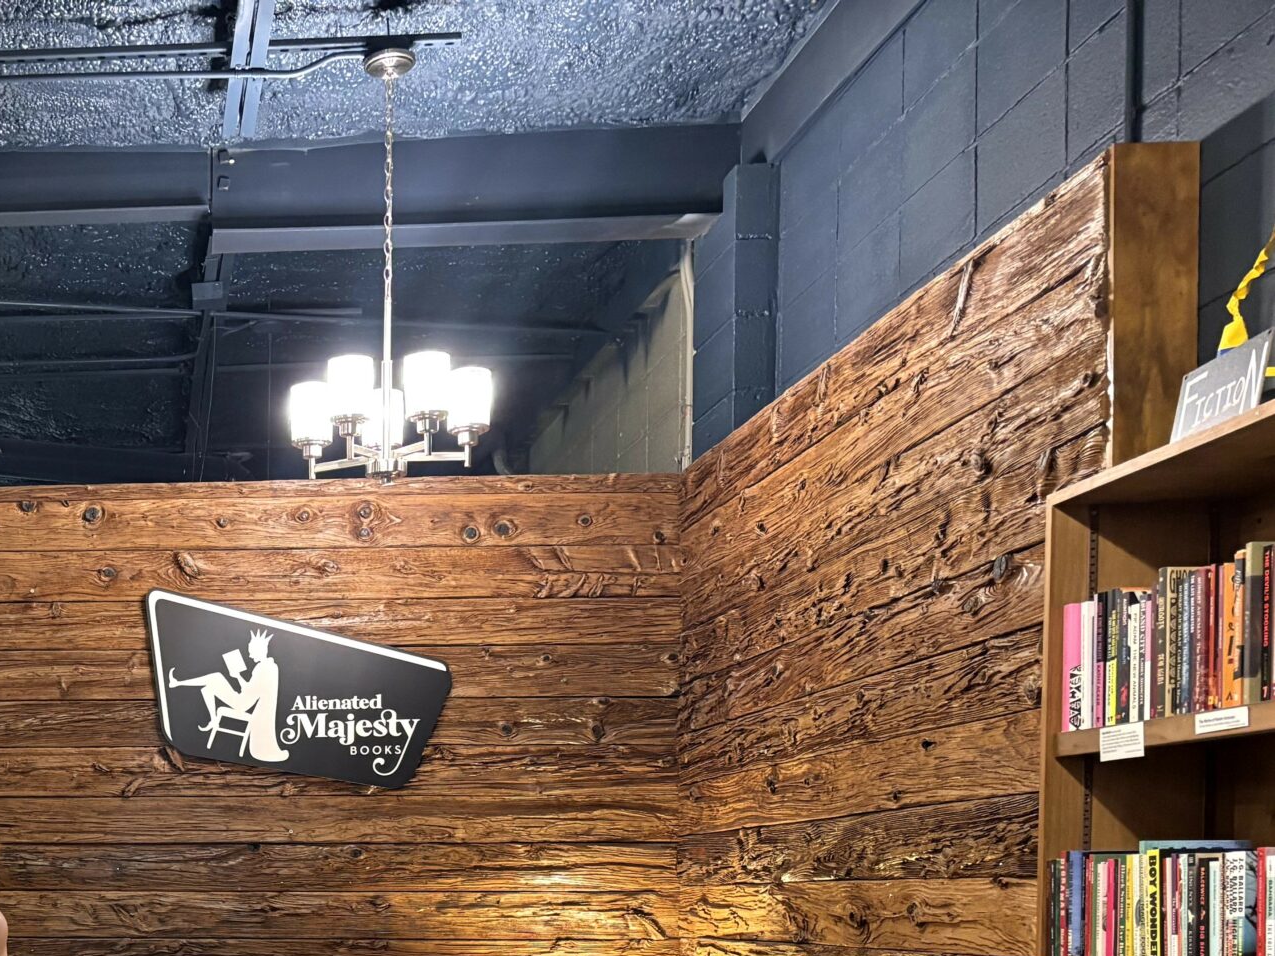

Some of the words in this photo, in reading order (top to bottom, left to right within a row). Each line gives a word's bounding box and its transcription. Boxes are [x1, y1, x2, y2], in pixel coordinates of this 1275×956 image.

[1177, 341, 1268, 441] FICTION
[291, 694, 382, 710] Alienated
[280, 709, 421, 776] Majesty
[350, 745, 402, 755] BOOKS
[1148, 855, 1157, 888] BOY
